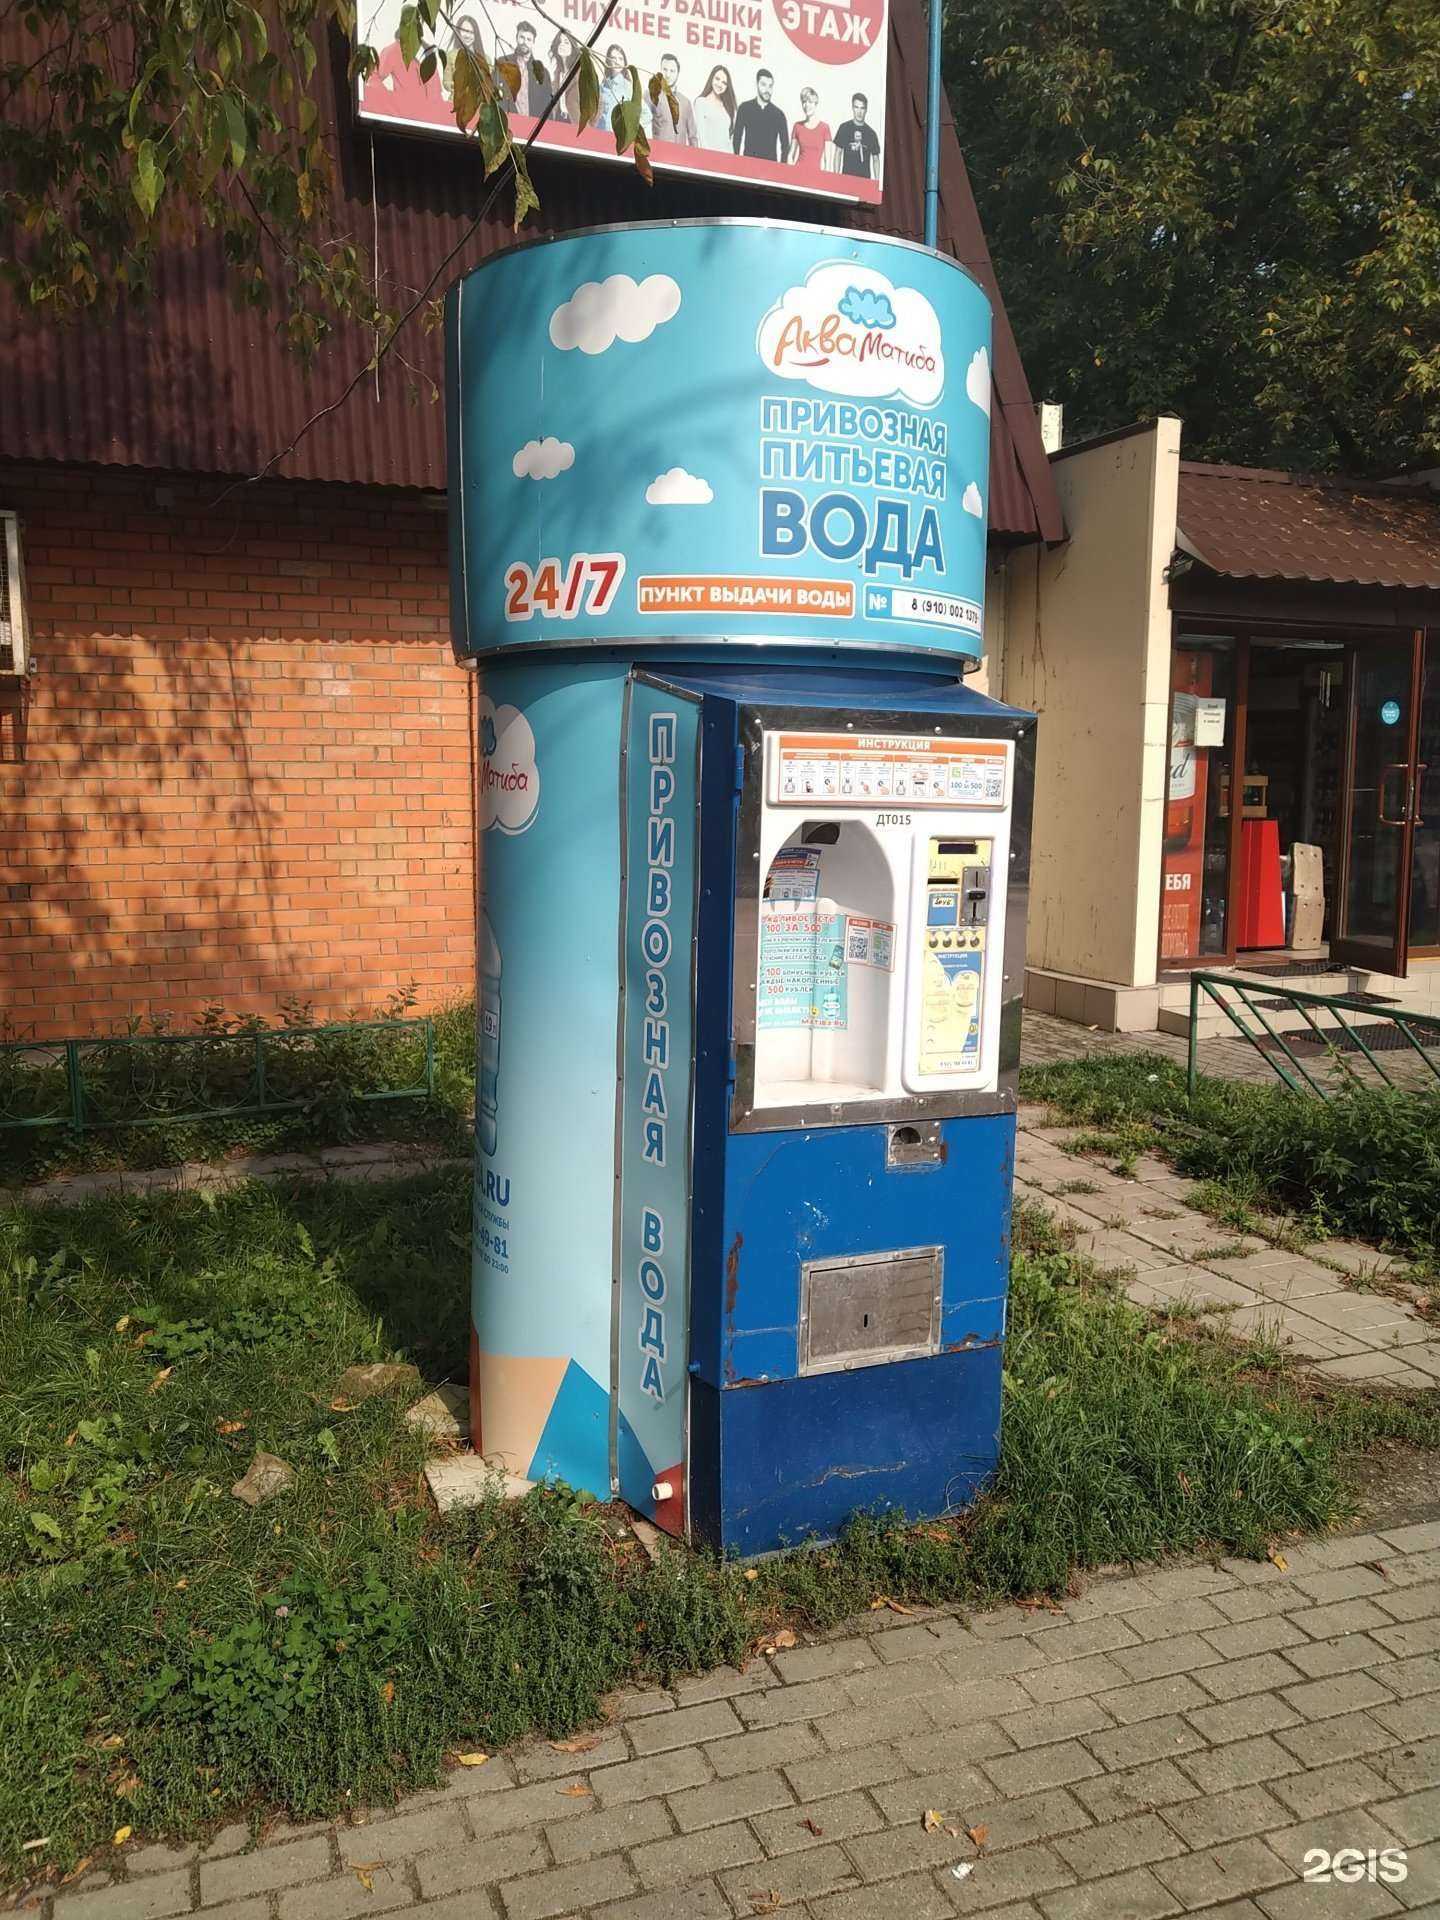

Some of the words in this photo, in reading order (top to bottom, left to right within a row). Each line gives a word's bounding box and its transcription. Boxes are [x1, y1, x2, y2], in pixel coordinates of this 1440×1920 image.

[563, 0, 671, 40] НИЖНЕЕ
[686, 21, 762, 59] БЕЛЬЕ
[644, 0, 762, 31] БАШКИ
[782, 0, 872, 47] ЭТАЖ
[762, 397, 946, 456] ПРИВОЗНАЯ
[762, 440, 946, 499] ПИТЬЕВАЯ
[762, 489, 945, 578] ВОДА
[506, 558, 621, 616] 24/7
[641, 585, 705, 604] ПУНКТ
[710, 586, 792, 606] ВЫДАЧИ
[797, 589, 852, 610] ВОДЫ
[868, 592, 888, 611] №
[911, 597, 918, 611] 8
[922, 600, 948, 616] (910)
[949, 604, 964, 618] 002
[857, 737, 931, 752] ИНСТРУКЦИЯ
[875, 814, 911, 827] ДТ015
[1165, 873, 1192, 891] ЕБЯ
[641, 712, 677, 1167] ПРИВОЗНАЯ
[639, 1206, 666, 1401] ВОДА
